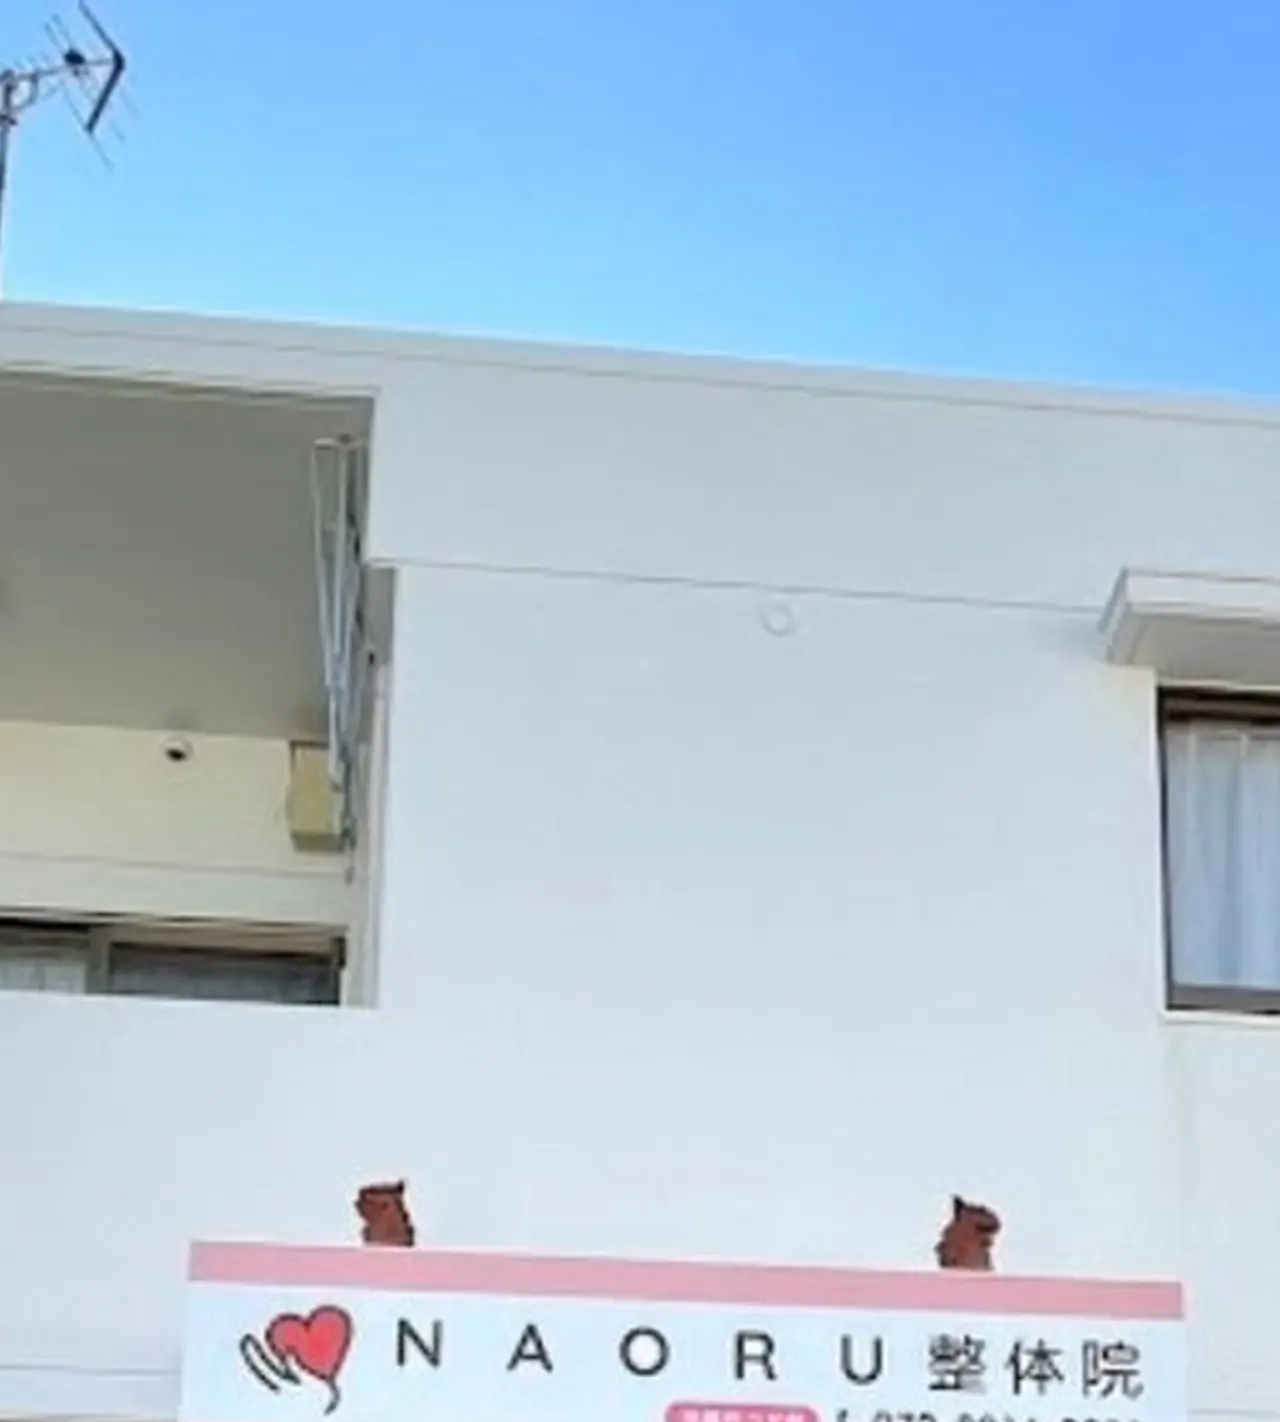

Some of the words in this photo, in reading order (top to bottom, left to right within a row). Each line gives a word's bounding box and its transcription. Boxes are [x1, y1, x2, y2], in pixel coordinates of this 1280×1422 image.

[395, 1318, 883, 1386] NAORU
[928, 1333, 1145, 1399] 整体院
